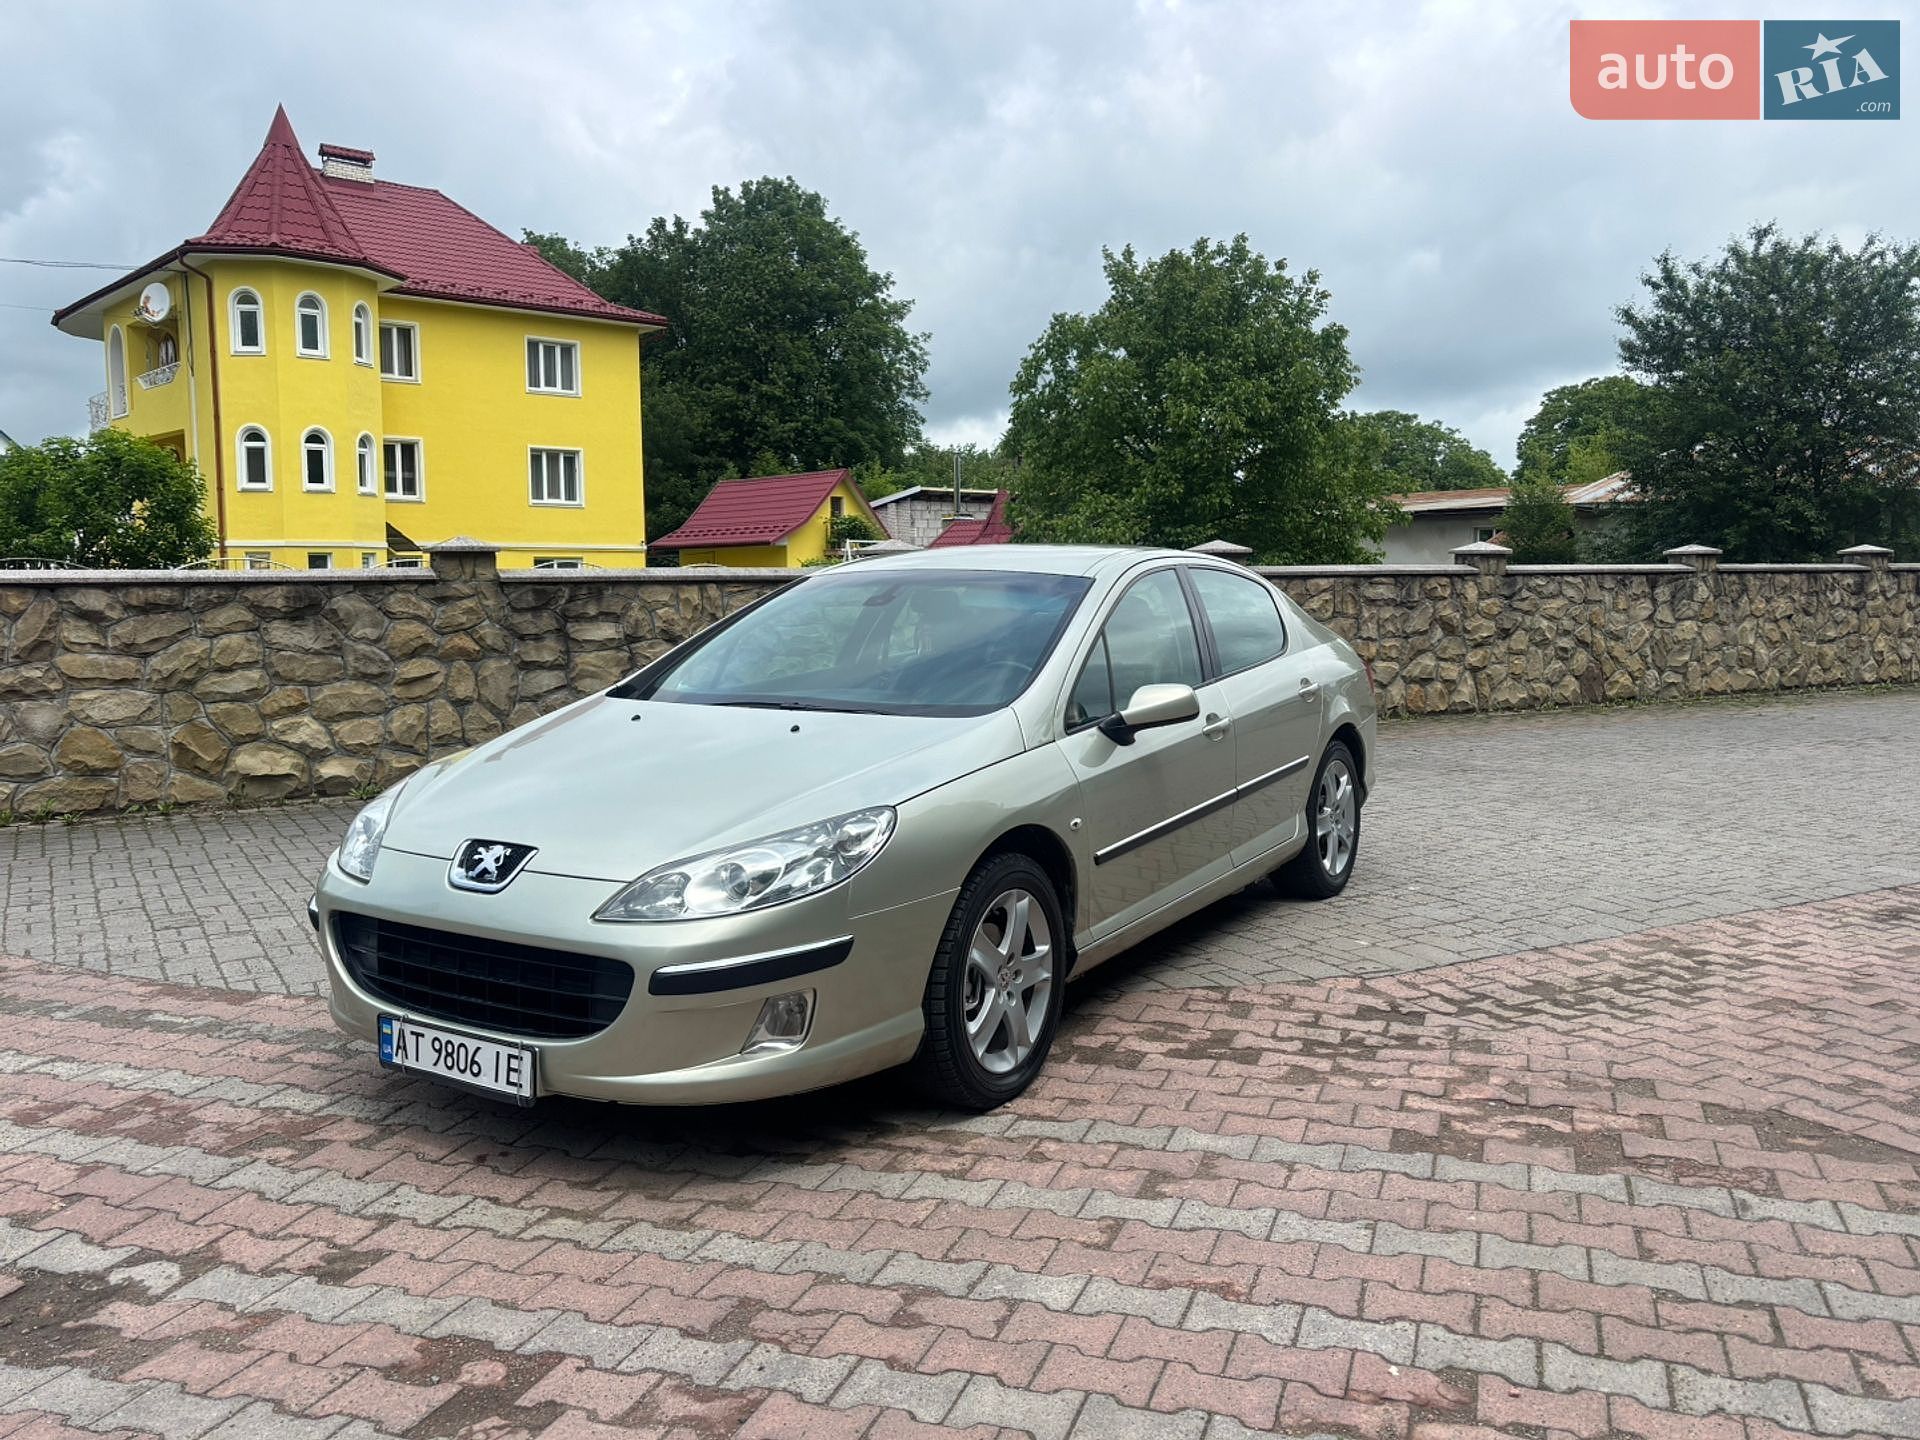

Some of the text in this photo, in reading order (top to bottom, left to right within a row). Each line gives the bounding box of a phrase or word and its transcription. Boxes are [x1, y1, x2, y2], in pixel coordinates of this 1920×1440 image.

[395, 1028, 523, 1088] AT 9806 IE
